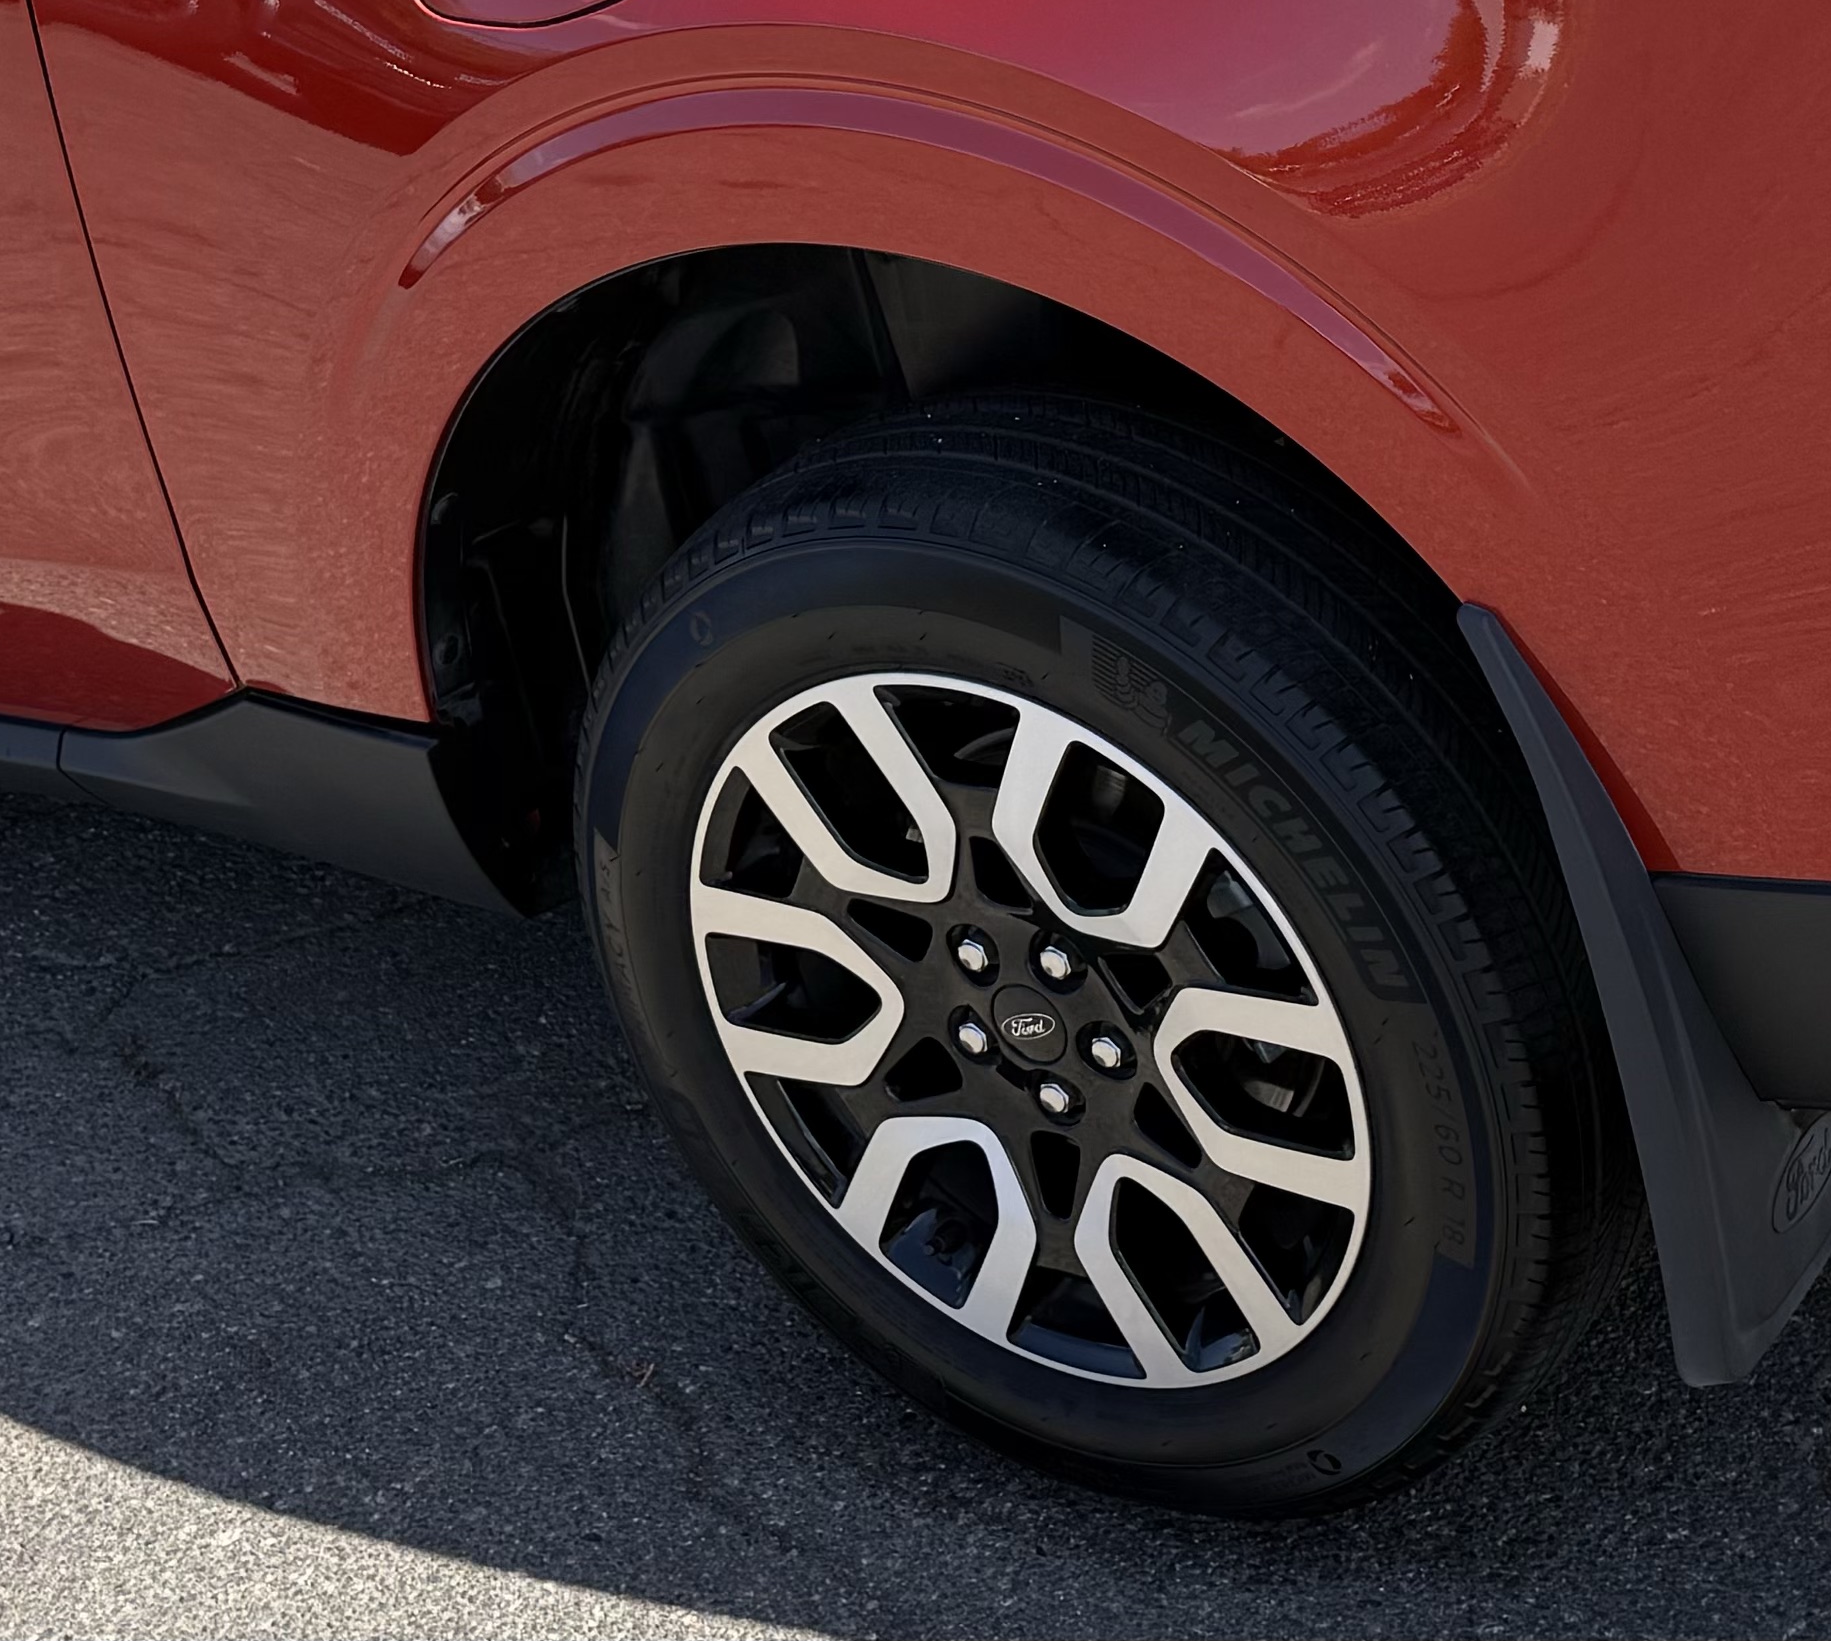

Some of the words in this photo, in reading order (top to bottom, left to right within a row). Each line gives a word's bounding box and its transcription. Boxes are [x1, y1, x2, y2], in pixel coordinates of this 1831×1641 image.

[1177, 719, 1410, 988] MICHELIN
[1009, 1016, 1047, 1037] Ford
[1412, 1030, 1463, 1166] 225/60
[1441, 1176, 1466, 1201] R
[1442, 1217, 1466, 1246] 18
